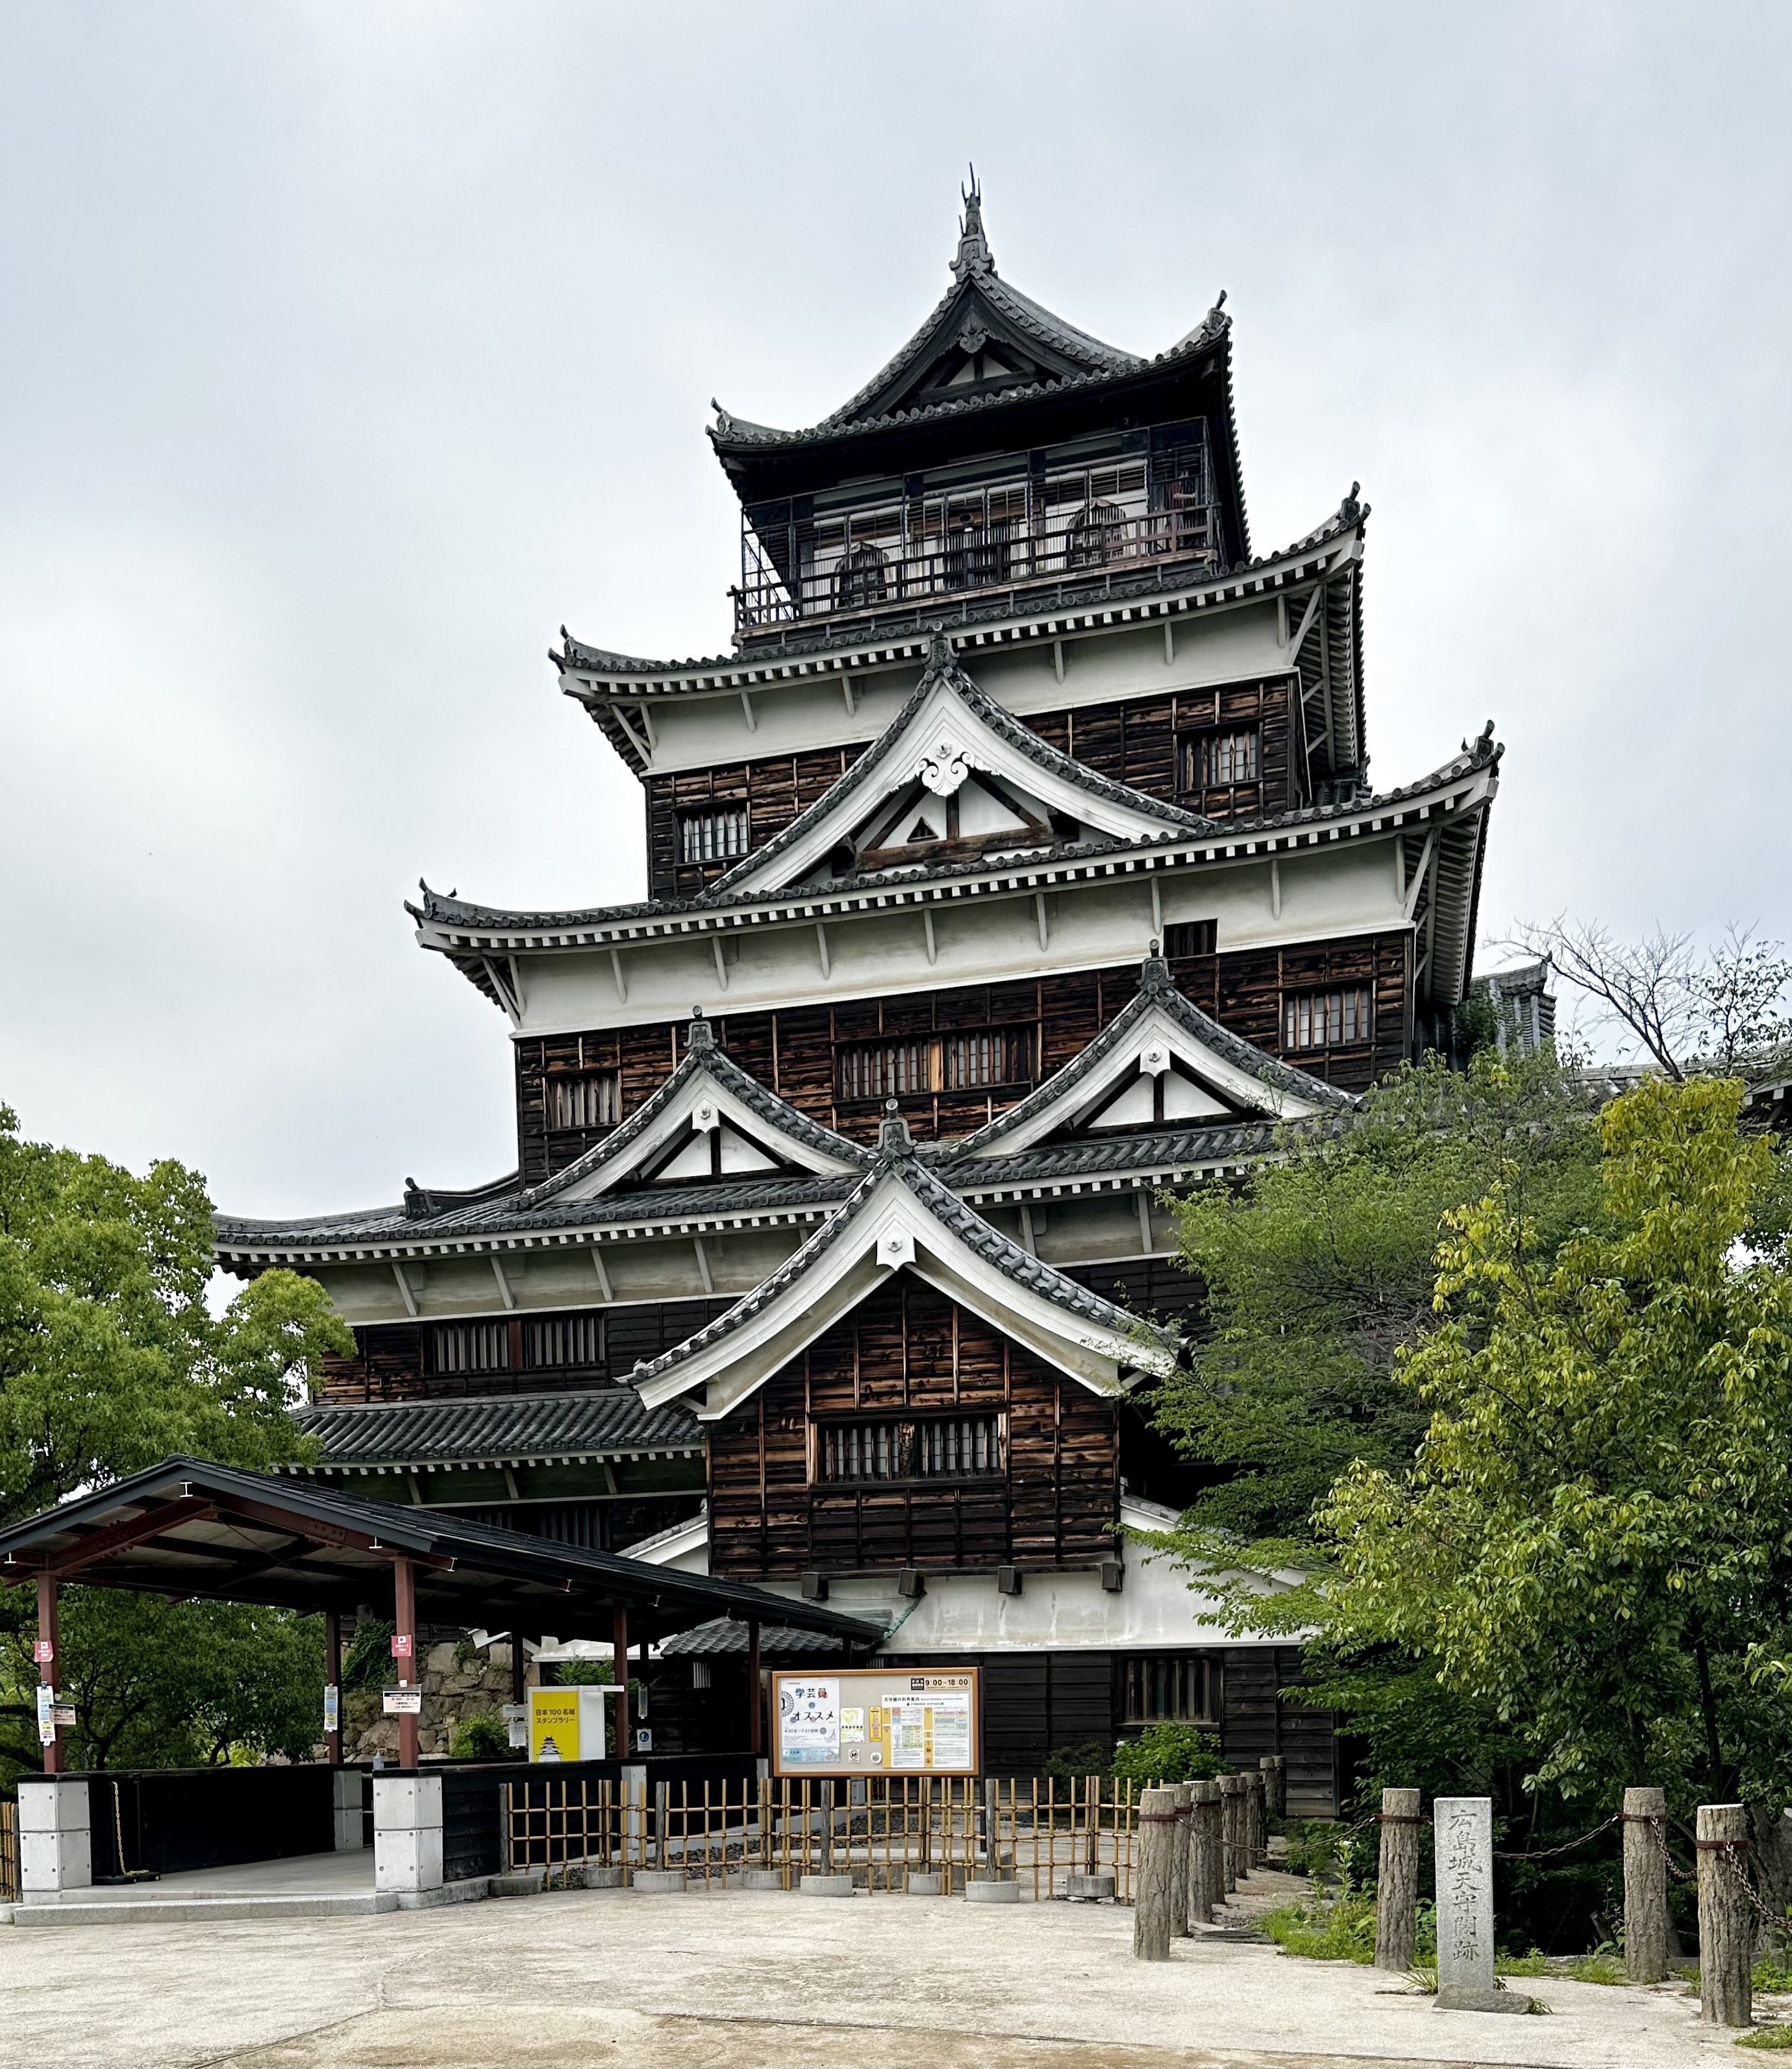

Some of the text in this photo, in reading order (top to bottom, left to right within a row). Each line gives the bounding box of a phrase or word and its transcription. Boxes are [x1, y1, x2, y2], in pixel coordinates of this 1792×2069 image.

[795, 1688, 827, 1698] 学芸員
[793, 1711, 834, 1721] オススメ
[1448, 1809, 1484, 1961] 広島城天守閣跡
